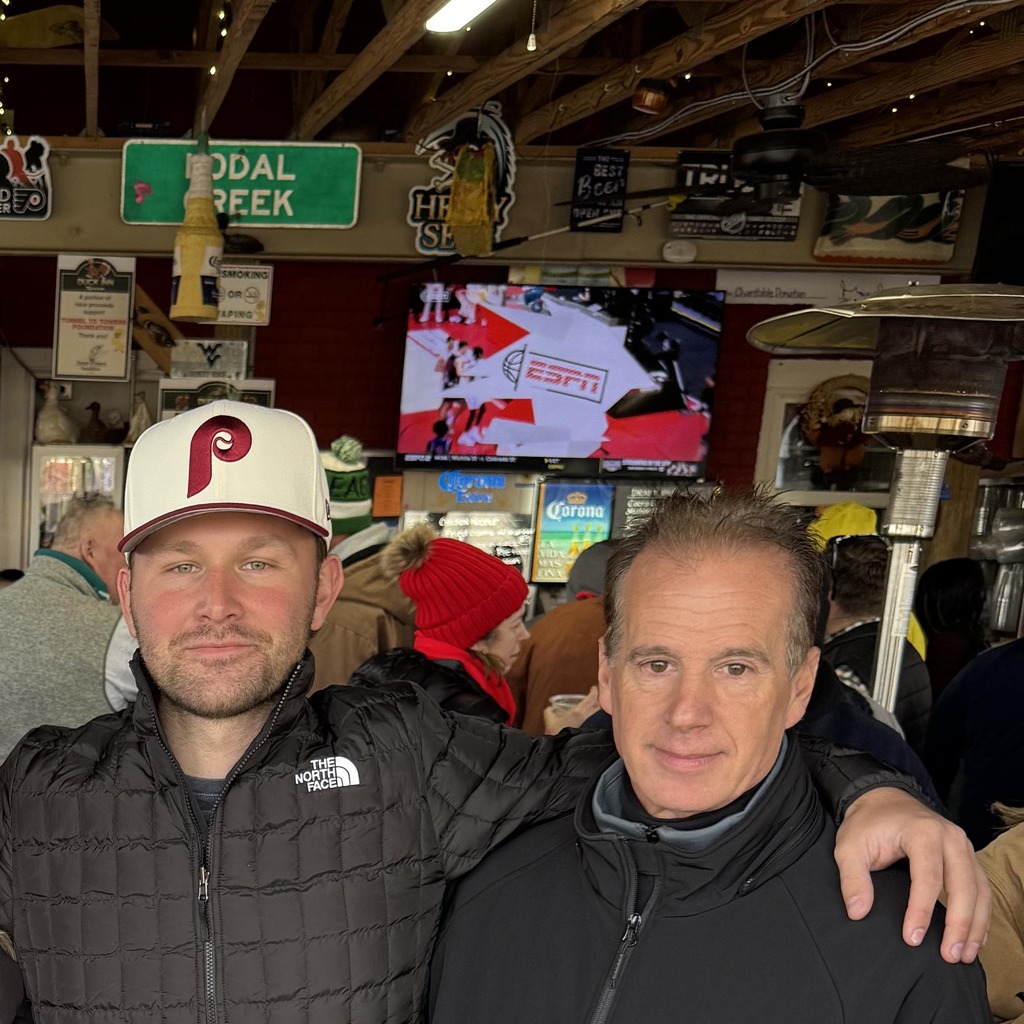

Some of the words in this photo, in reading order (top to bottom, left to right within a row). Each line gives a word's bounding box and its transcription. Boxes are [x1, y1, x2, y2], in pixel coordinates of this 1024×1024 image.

[185, 152, 297, 181] ODAL
[592, 163, 625, 177] BEST
[183, 188, 294, 217] REEK
[221, 270, 269, 280] SMOKING
[227, 290, 243, 299] OR
[545, 500, 605, 522] Corona
[309, 757, 336, 770] THE
[295, 767, 336, 785] NORTH
[307, 777, 338, 793] FACE
